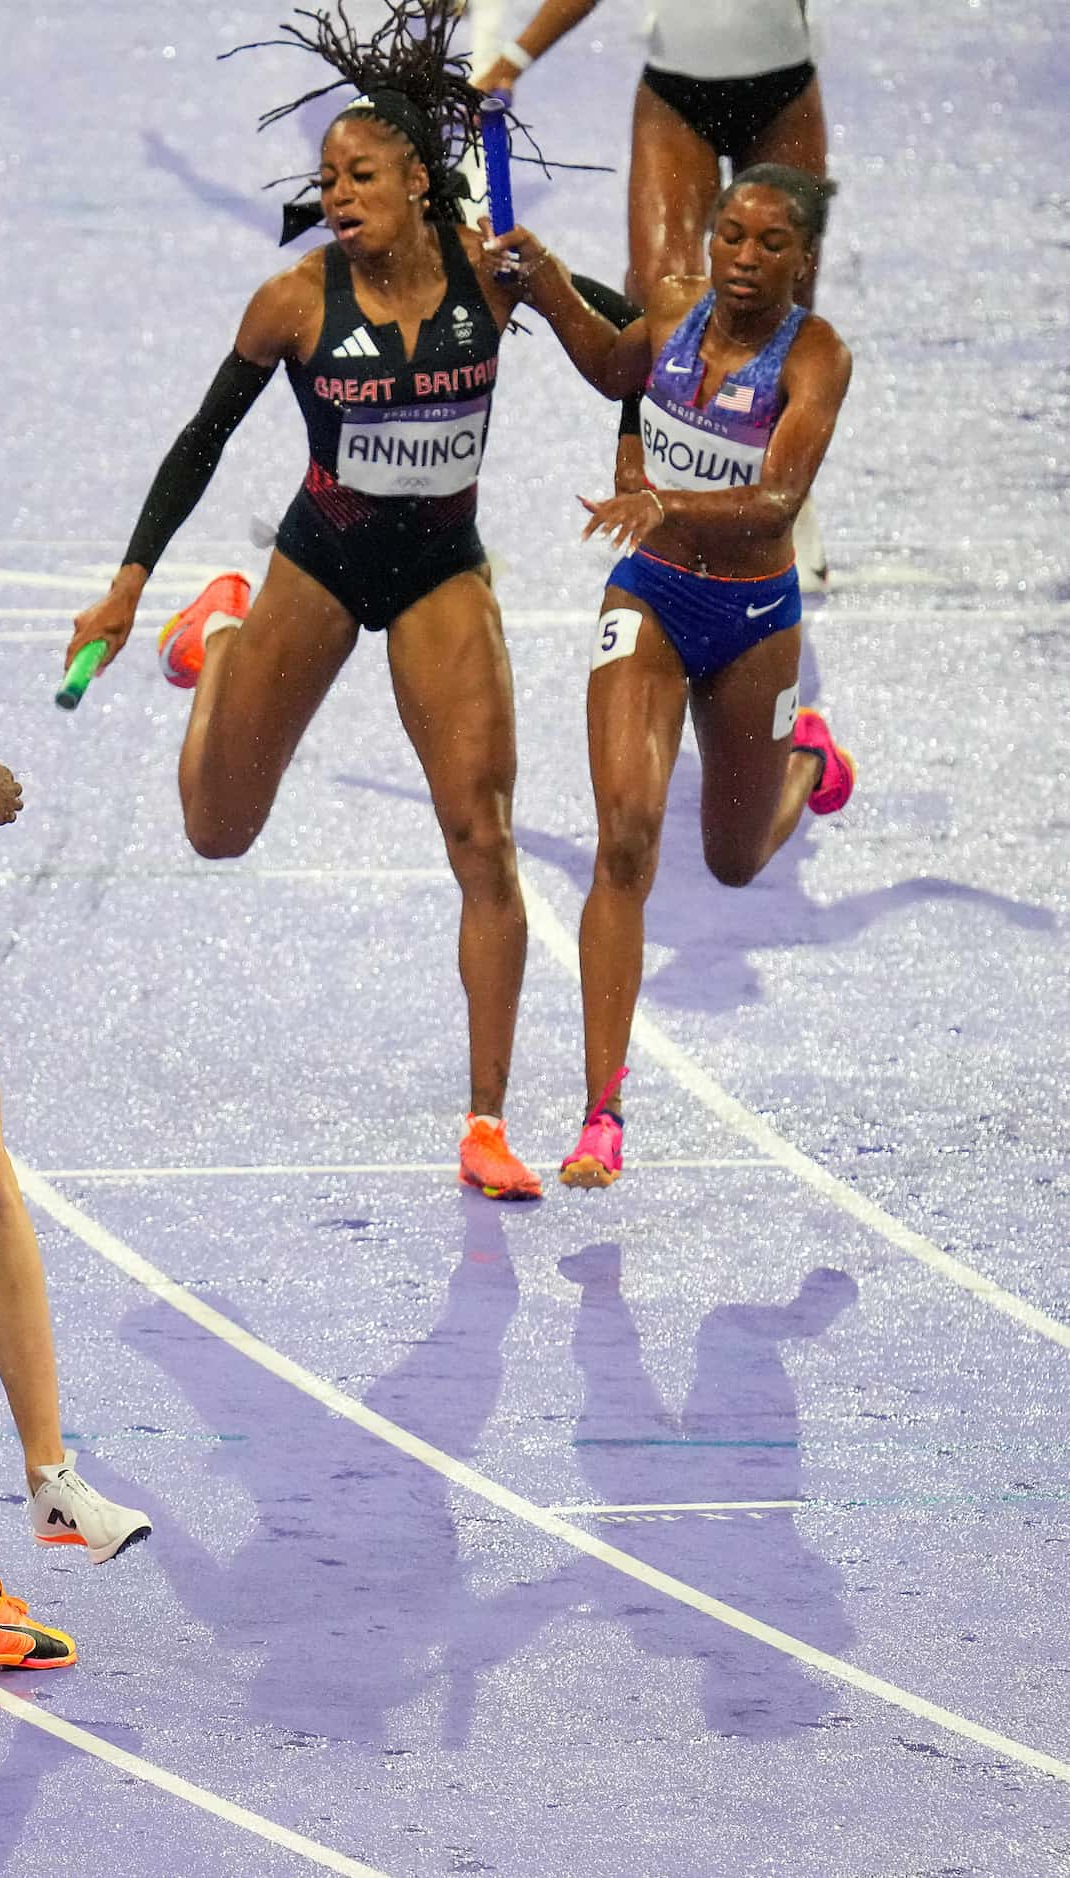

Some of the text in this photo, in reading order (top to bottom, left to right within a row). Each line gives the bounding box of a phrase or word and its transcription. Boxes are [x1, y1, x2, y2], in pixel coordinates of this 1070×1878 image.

[314, 376, 396, 402] GREAT
[348, 430, 476, 467] ANNING
[643, 418, 754, 486] BROWN
[601, 620, 619, 652] 5
